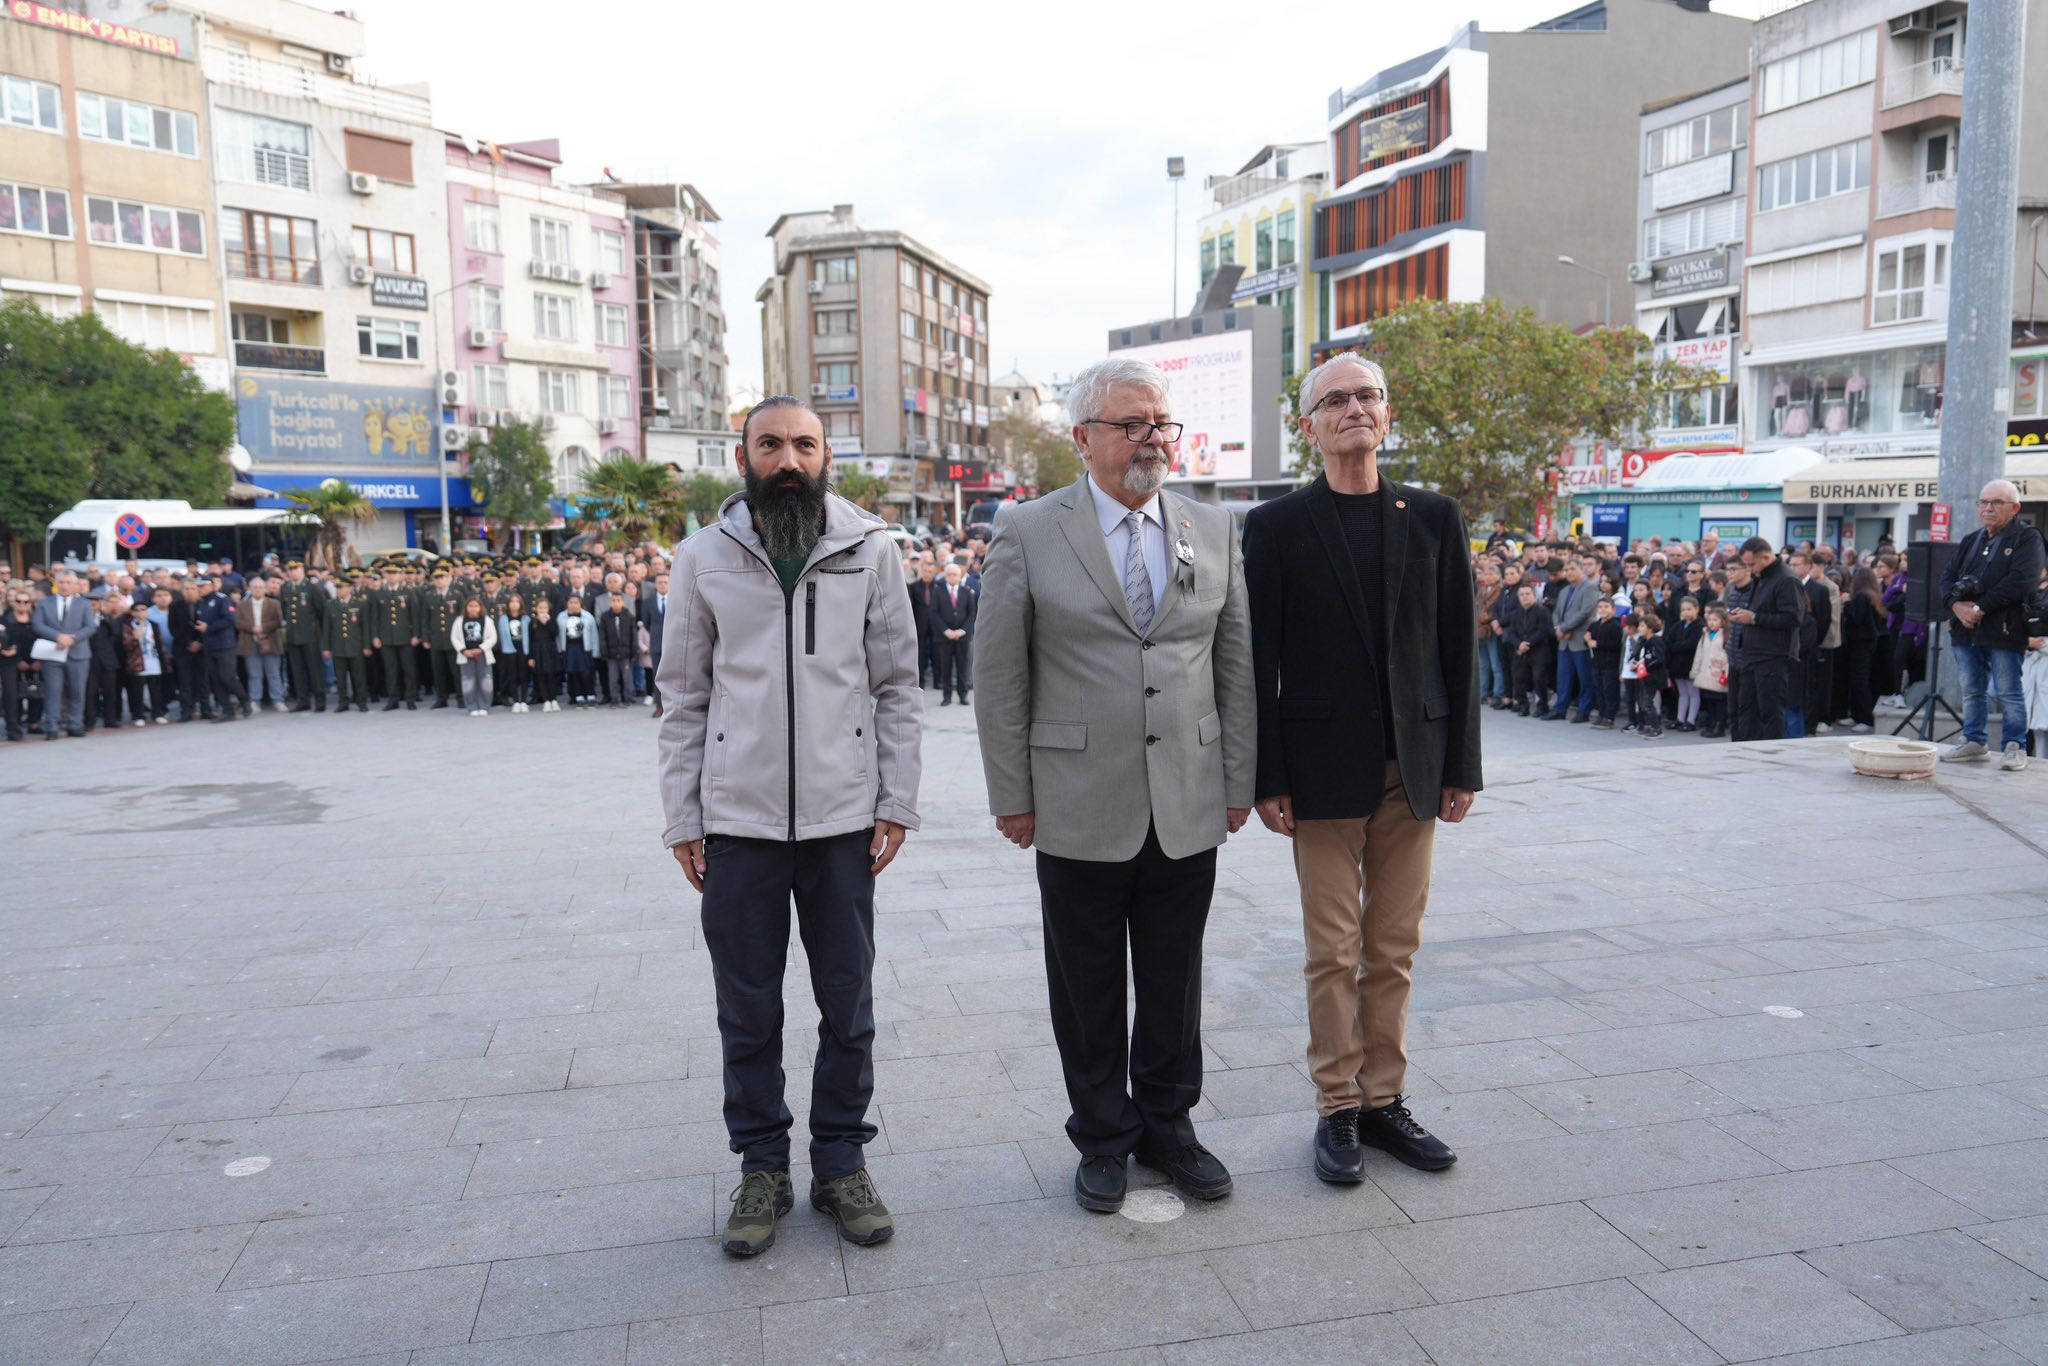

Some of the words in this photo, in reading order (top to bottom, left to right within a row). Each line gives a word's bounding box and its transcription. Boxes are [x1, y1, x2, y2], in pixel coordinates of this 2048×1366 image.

[37, 6, 95, 35] EMEK
[1665, 258, 1713, 278] AVUKAT
[374, 277, 426, 297] AVUKAT
[1702, 340, 1728, 353] YAP
[1164, 357, 1189, 372] DOST
[1191, 350, 1242, 369] PROGRAMI
[269, 390, 359, 411] Turkcell'le
[270, 410, 335, 431] bağlan
[271, 428, 343, 451] hayata!
